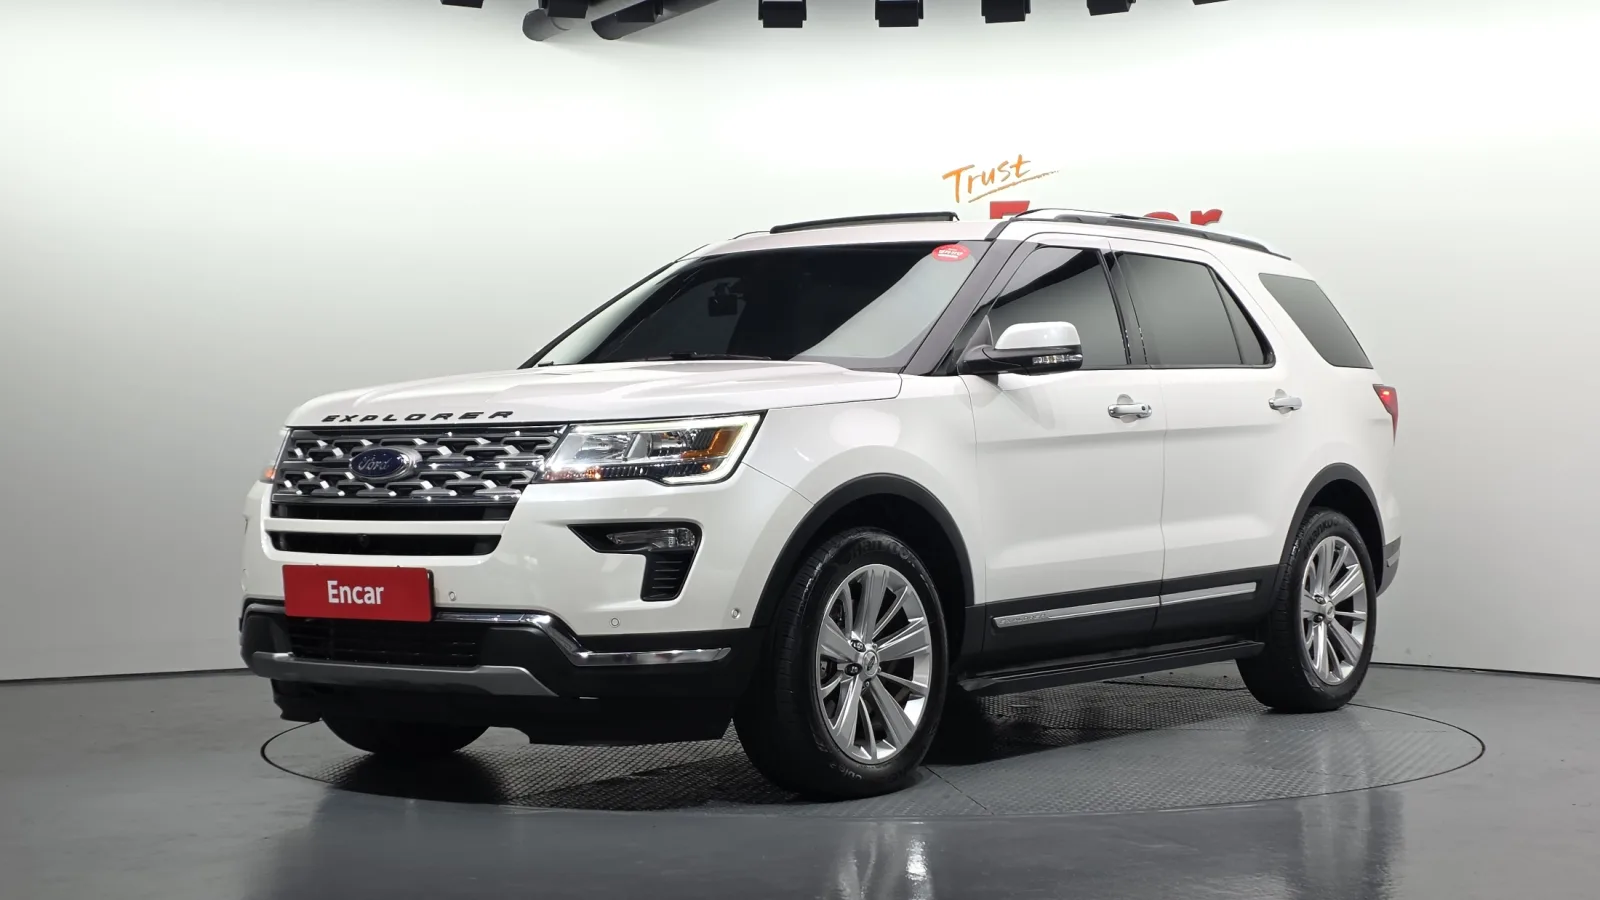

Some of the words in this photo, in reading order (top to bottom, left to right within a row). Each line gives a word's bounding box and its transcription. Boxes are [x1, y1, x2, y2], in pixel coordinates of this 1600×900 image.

[942, 154, 1031, 203] Trust
[321, 410, 514, 423] EXPLORER
[357, 455, 392, 471] Ford
[327, 580, 384, 605] Encar
